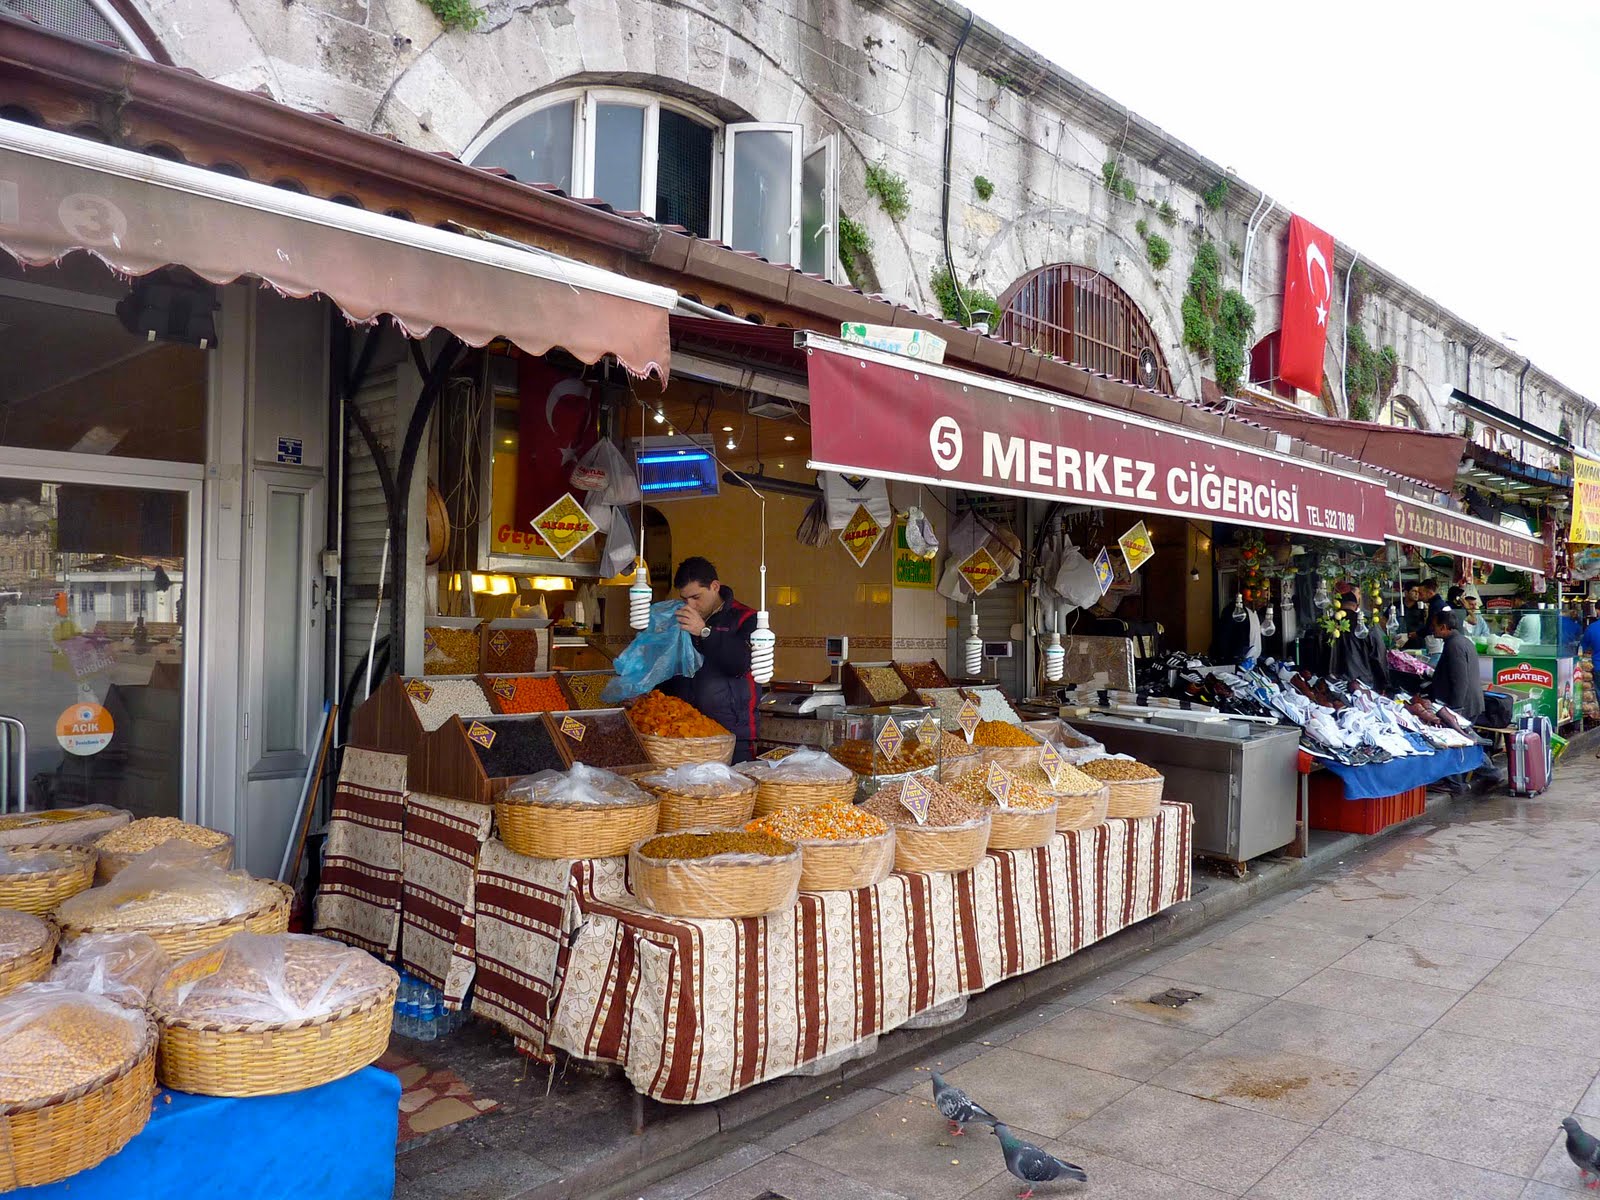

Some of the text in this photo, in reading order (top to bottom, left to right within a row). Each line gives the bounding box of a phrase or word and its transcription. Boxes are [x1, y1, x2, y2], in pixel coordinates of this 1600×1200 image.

[982, 430, 1158, 501] MERKEZ
[1166, 460, 1300, 523] CİĞERCİSİ
[1306, 505, 1324, 527] TEL.
[1324, 508, 1337, 529] 522
[1337, 511, 1347, 531] 70
[1347, 514, 1355, 533] 89
[541, 520, 590, 532] MERKEZ
[1408, 511, 1435, 539] TAZE
[1436, 517, 1474, 550] BALIKÇI
[1475, 530, 1499, 553] KOLL.
[1499, 673, 1550, 683] MURATBEY
[72, 723, 99, 735] AÇIK
